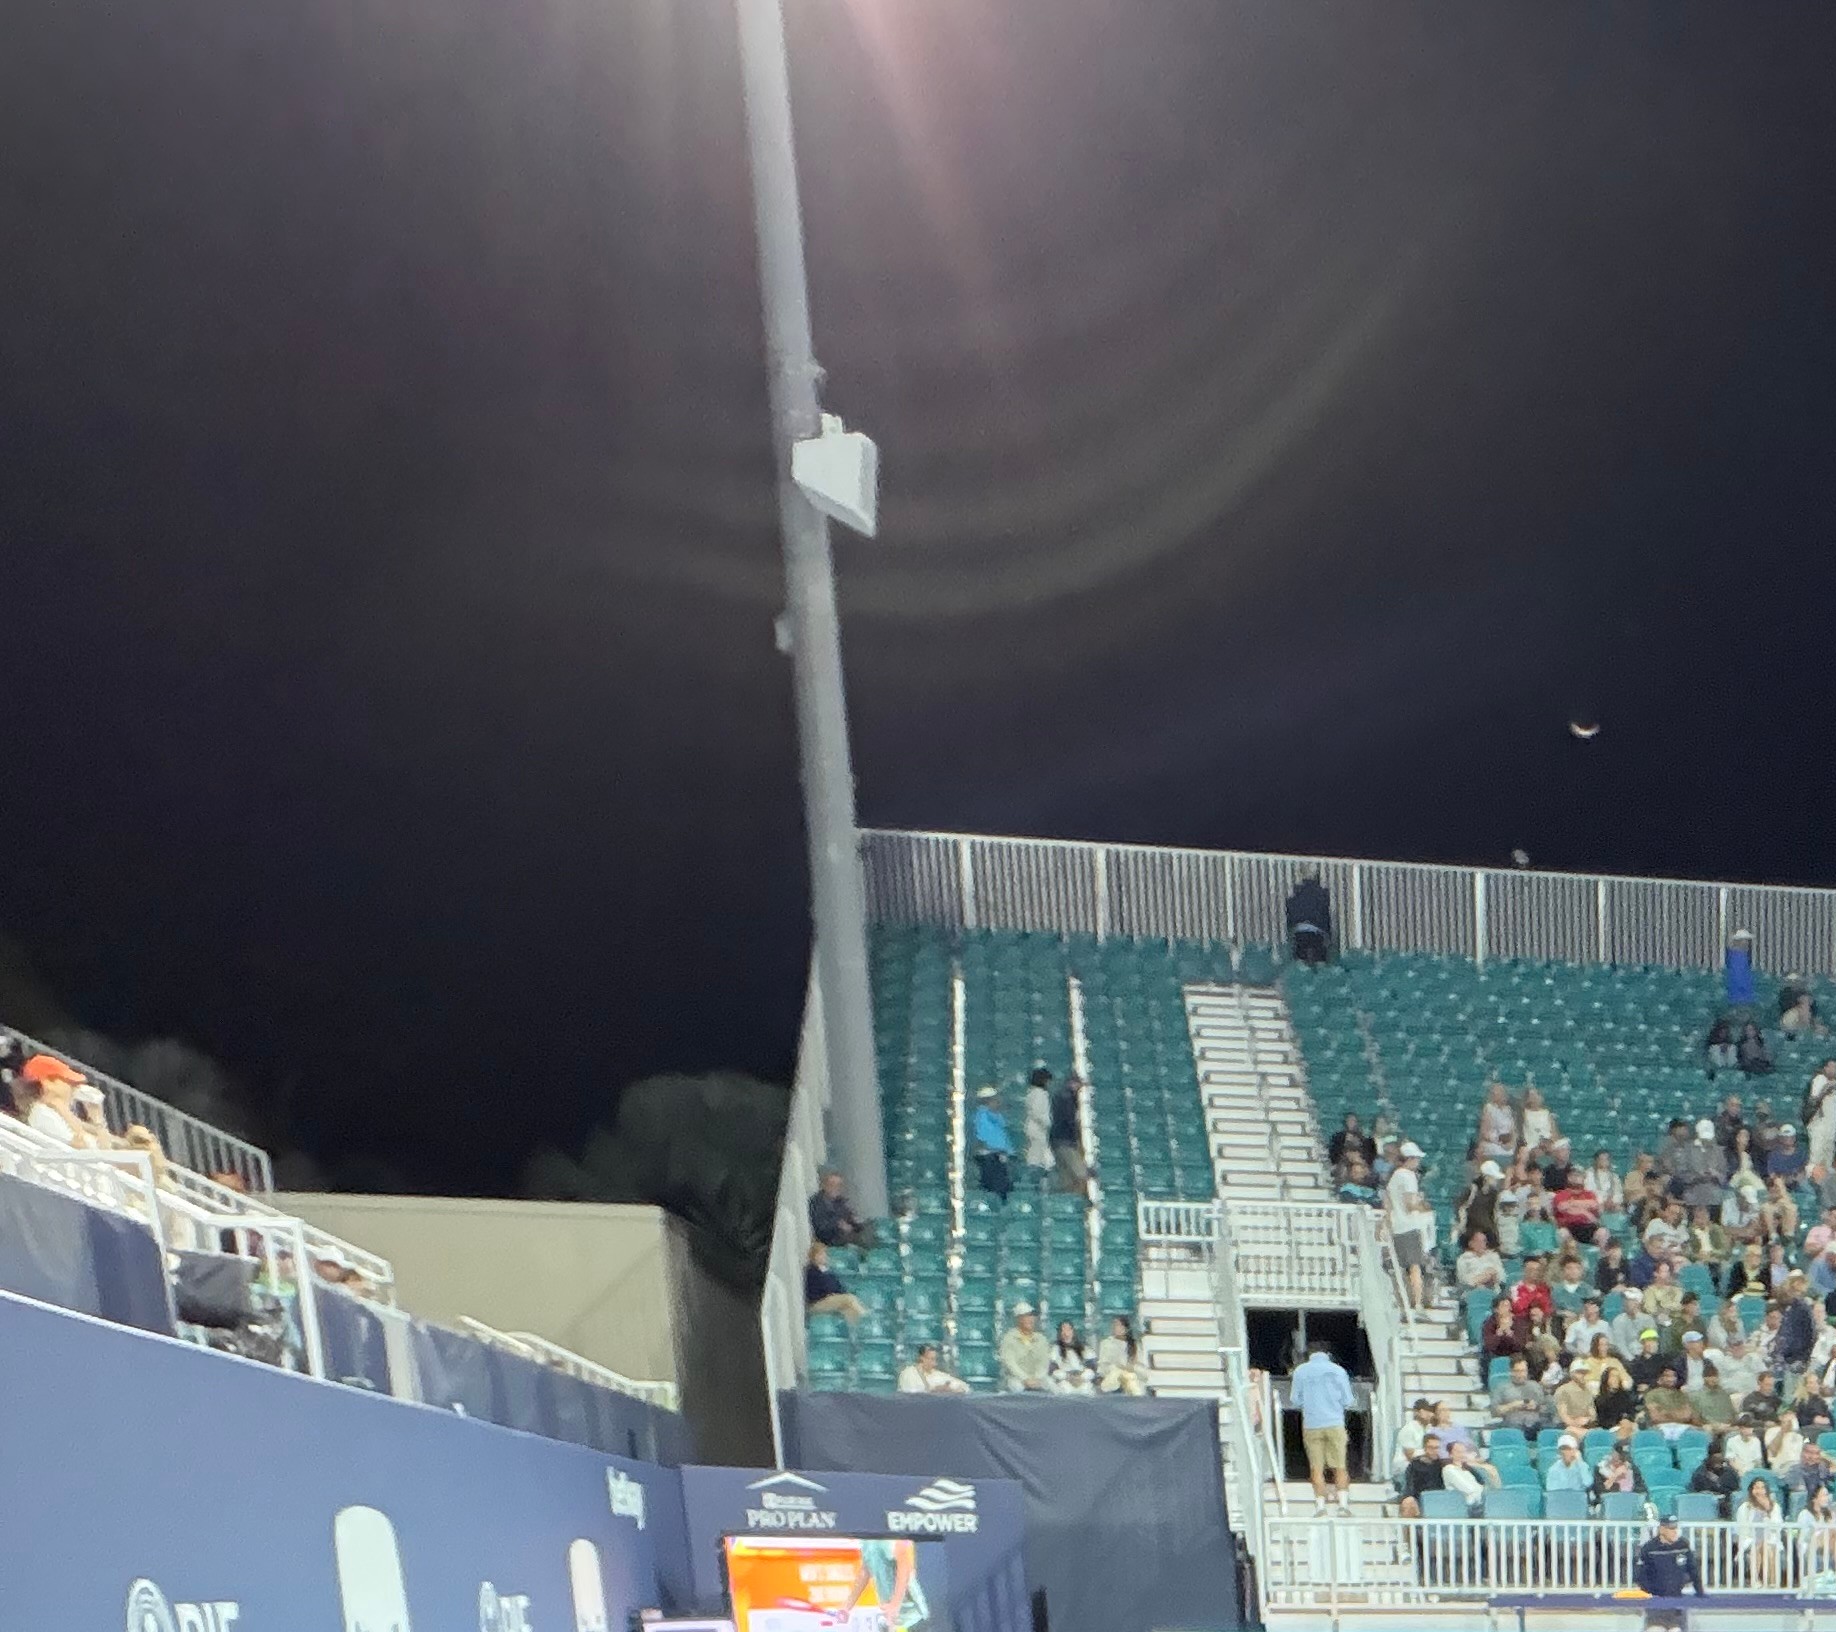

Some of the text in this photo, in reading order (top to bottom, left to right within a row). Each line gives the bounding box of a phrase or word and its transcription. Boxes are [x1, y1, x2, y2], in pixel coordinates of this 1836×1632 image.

[746, 1508, 837, 1531] PRO PLAN
[886, 1510, 980, 1534] EMPOWER
